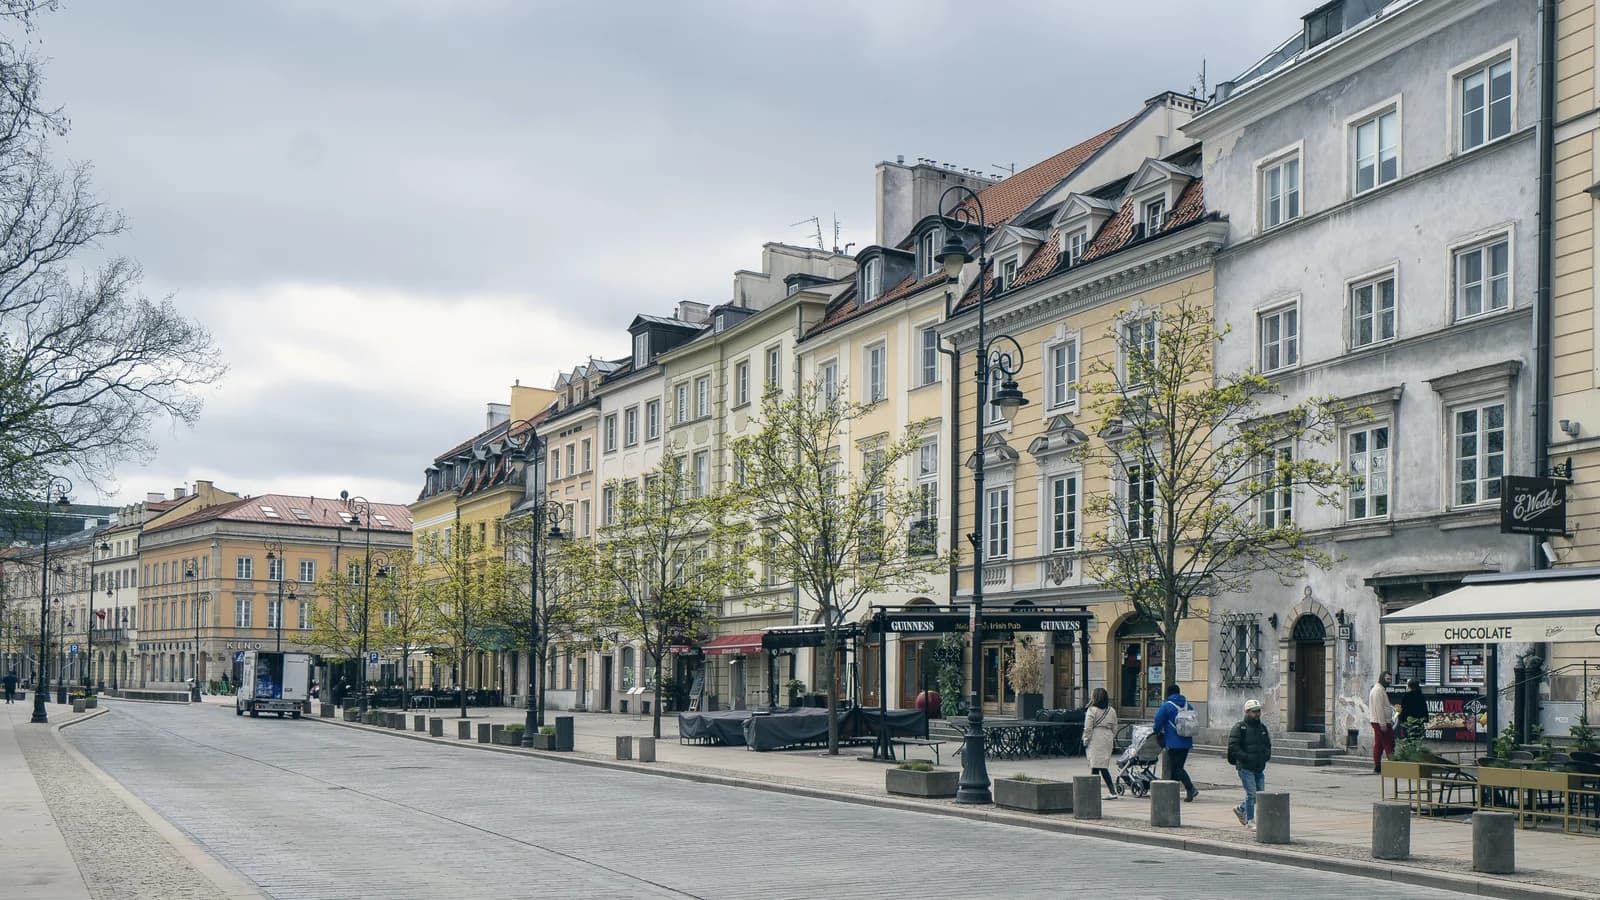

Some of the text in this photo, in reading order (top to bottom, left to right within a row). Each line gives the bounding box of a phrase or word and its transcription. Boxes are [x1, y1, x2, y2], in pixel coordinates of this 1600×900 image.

[891, 620, 934, 631] GUINNESS
[1041, 620, 1080, 631] GUINNESS
[1444, 626, 1512, 640] CHOCOLATE
[226, 642, 262, 650] KINO
